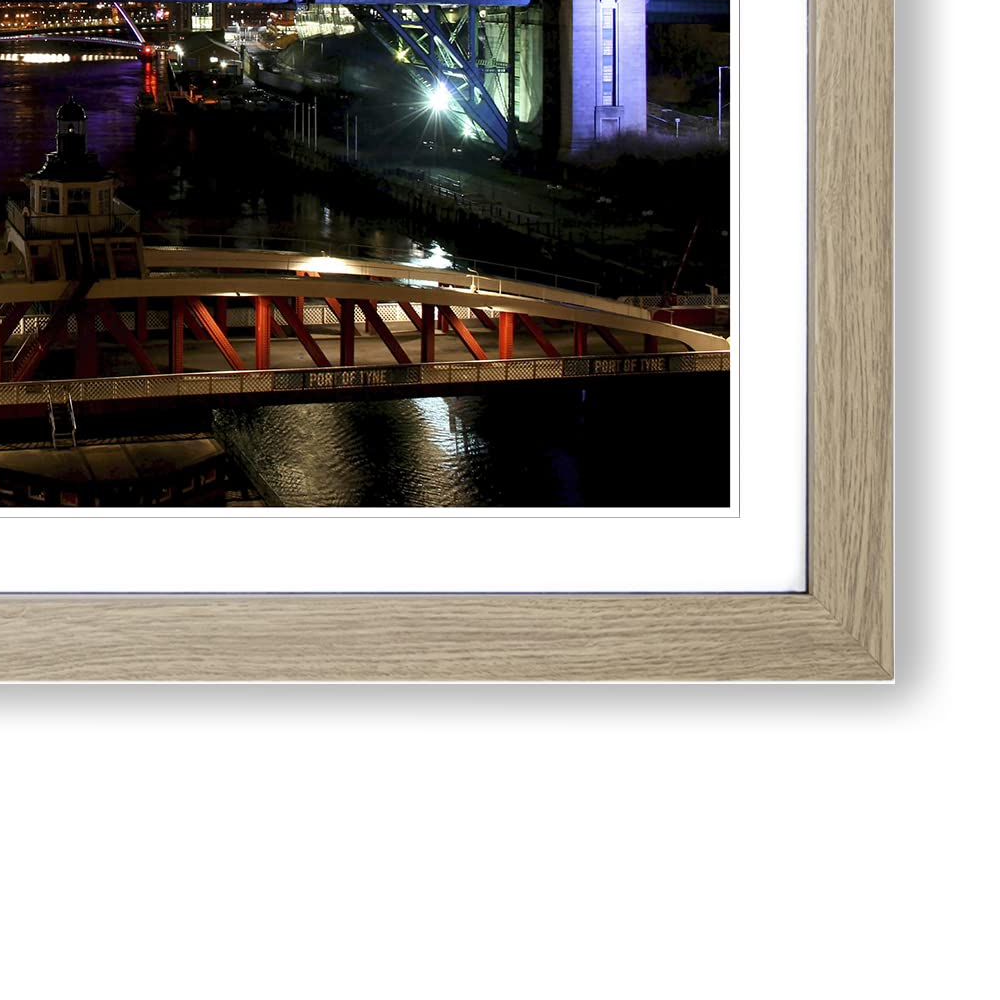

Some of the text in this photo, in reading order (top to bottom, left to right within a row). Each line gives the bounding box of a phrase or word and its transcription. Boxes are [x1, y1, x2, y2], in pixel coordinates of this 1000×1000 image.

[624, 358, 637, 372] OF
[640, 357, 665, 371] TYNE
[342, 370, 356, 384] OF
[359, 369, 387, 384] TYNE
